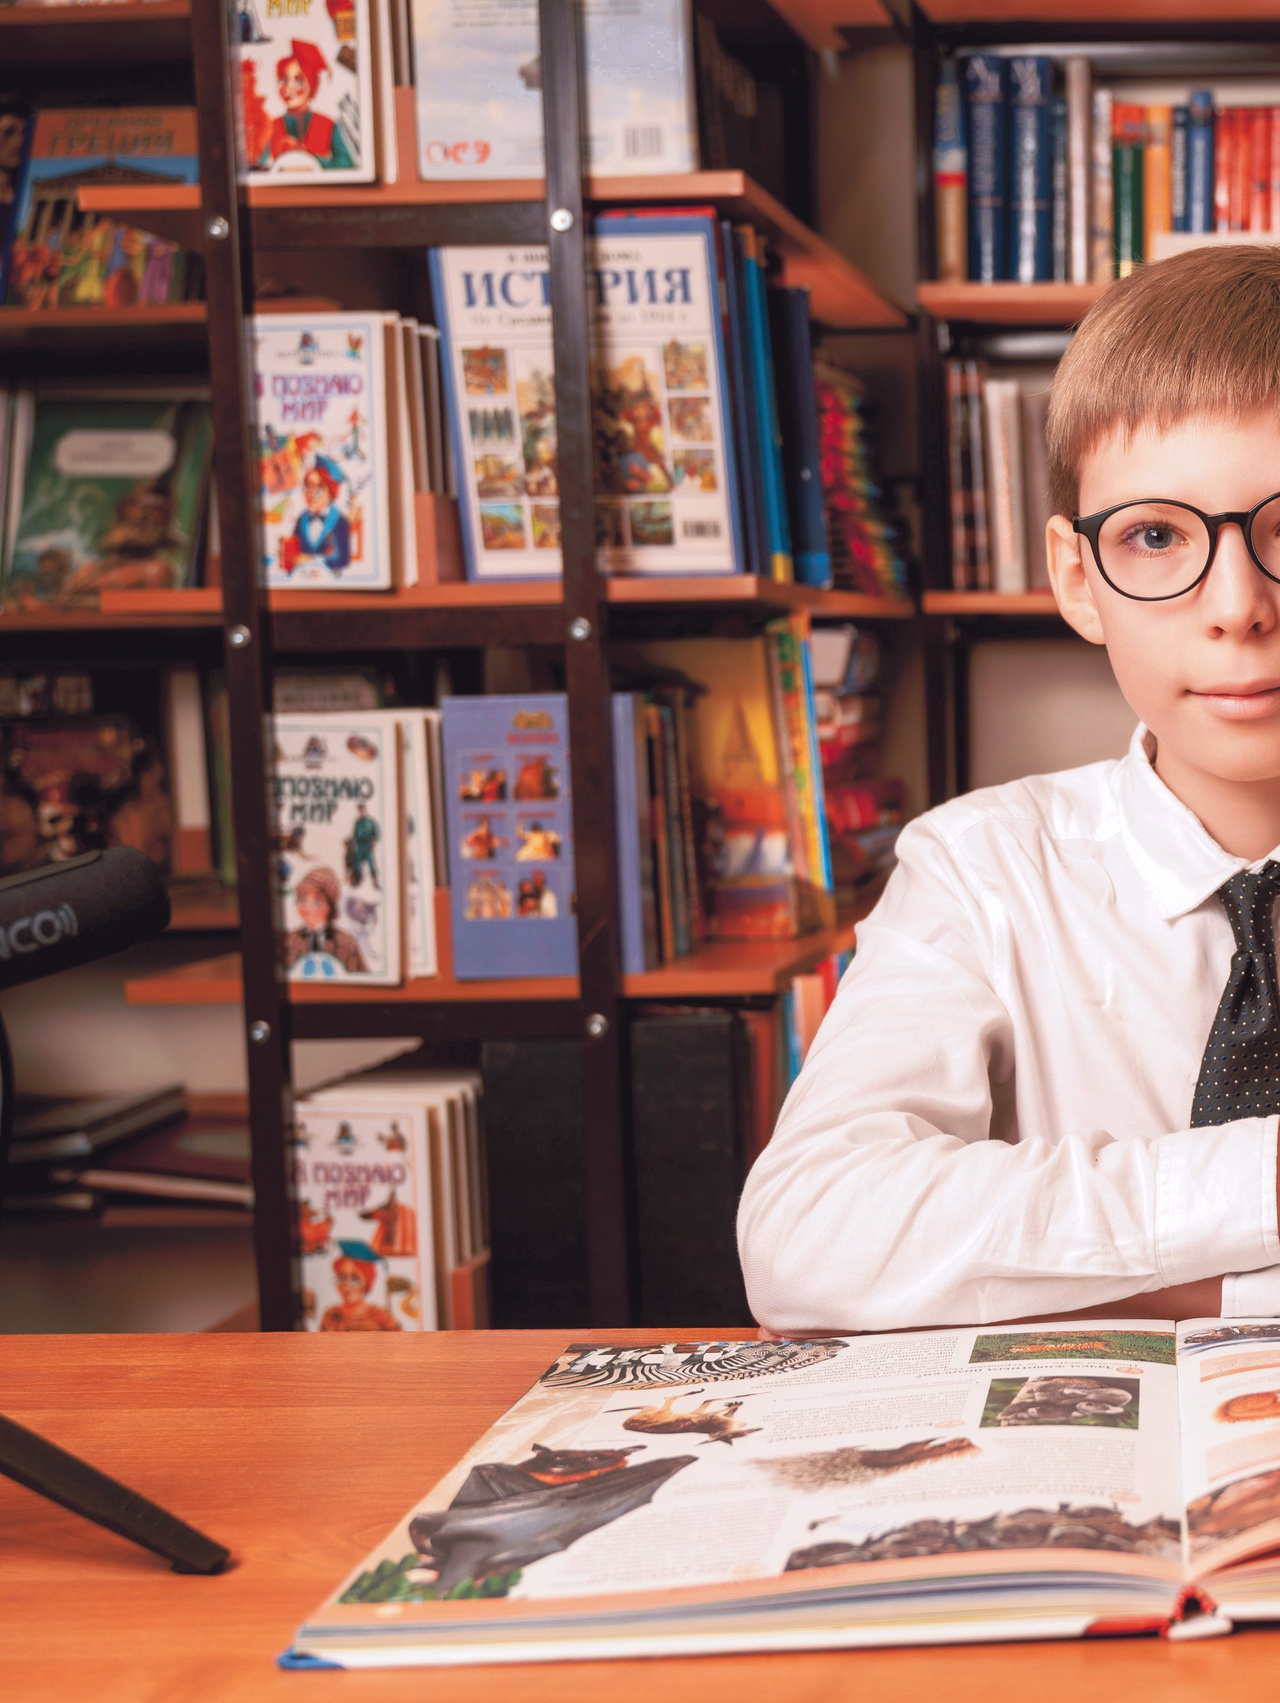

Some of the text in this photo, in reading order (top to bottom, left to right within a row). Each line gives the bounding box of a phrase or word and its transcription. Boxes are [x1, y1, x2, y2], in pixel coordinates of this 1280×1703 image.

[462, 268, 692, 308] ИСТРИЯ
[272, 372, 364, 396] ПОЗНАЮ
[281, 400, 329, 422] МИР
[290, 801, 338, 824] МИР
[313, 1161, 407, 1186] ПОЗНАЮ
[325, 1186, 370, 1208] МИР
